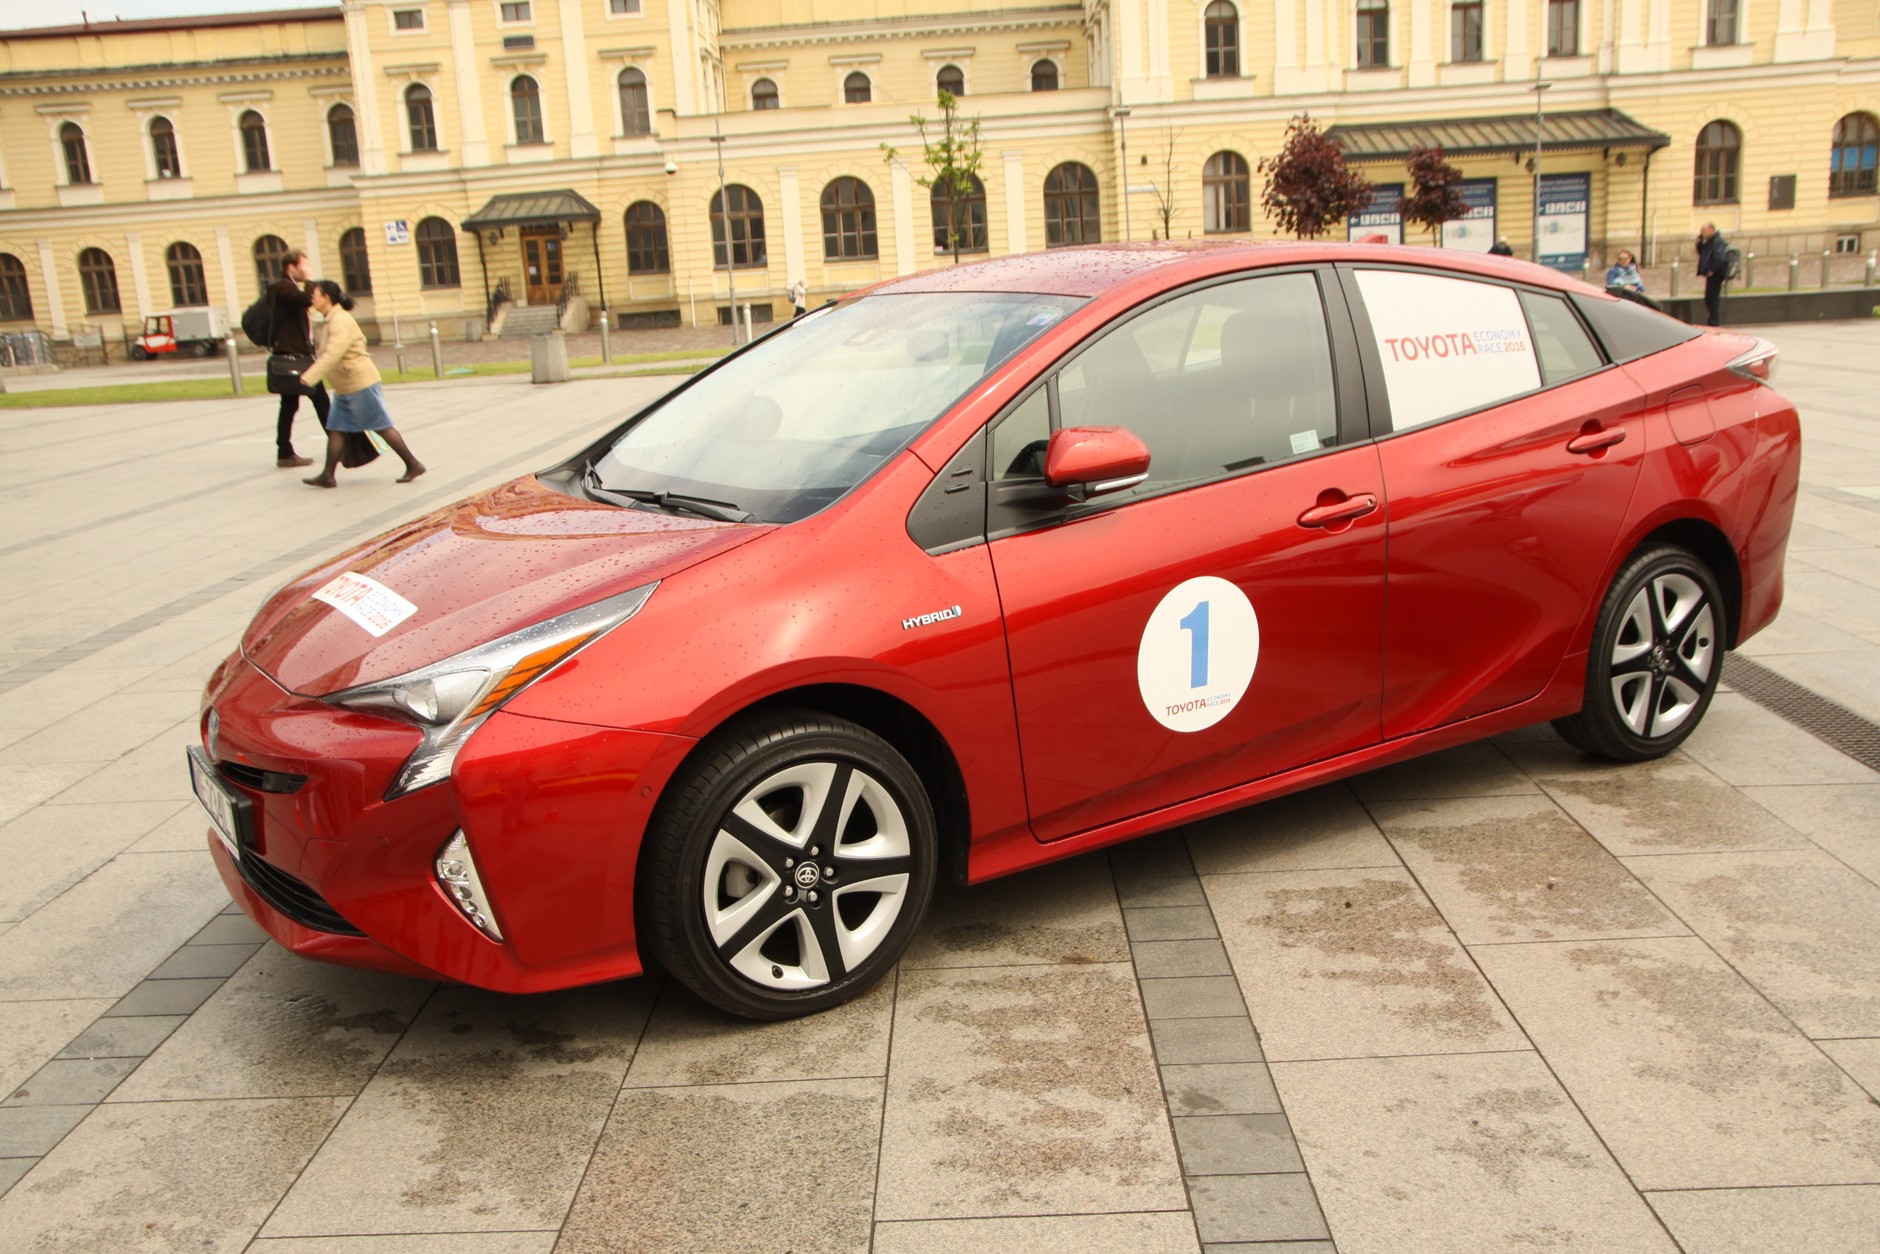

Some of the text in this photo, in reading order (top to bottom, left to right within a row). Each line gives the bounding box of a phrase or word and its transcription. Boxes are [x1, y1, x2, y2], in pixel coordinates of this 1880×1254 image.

[1473, 329, 1521, 343] ECONOMY
[1384, 332, 1478, 362] TOYOTA
[1477, 340, 1527, 354] RACE 2016
[367, 611, 393, 629] 2016
[901, 609, 954, 630] HYBRID
[1180, 600, 1209, 689] 1
[1207, 692, 1231, 702] ECONOMY
[1165, 698, 1207, 716] TOYOTA
